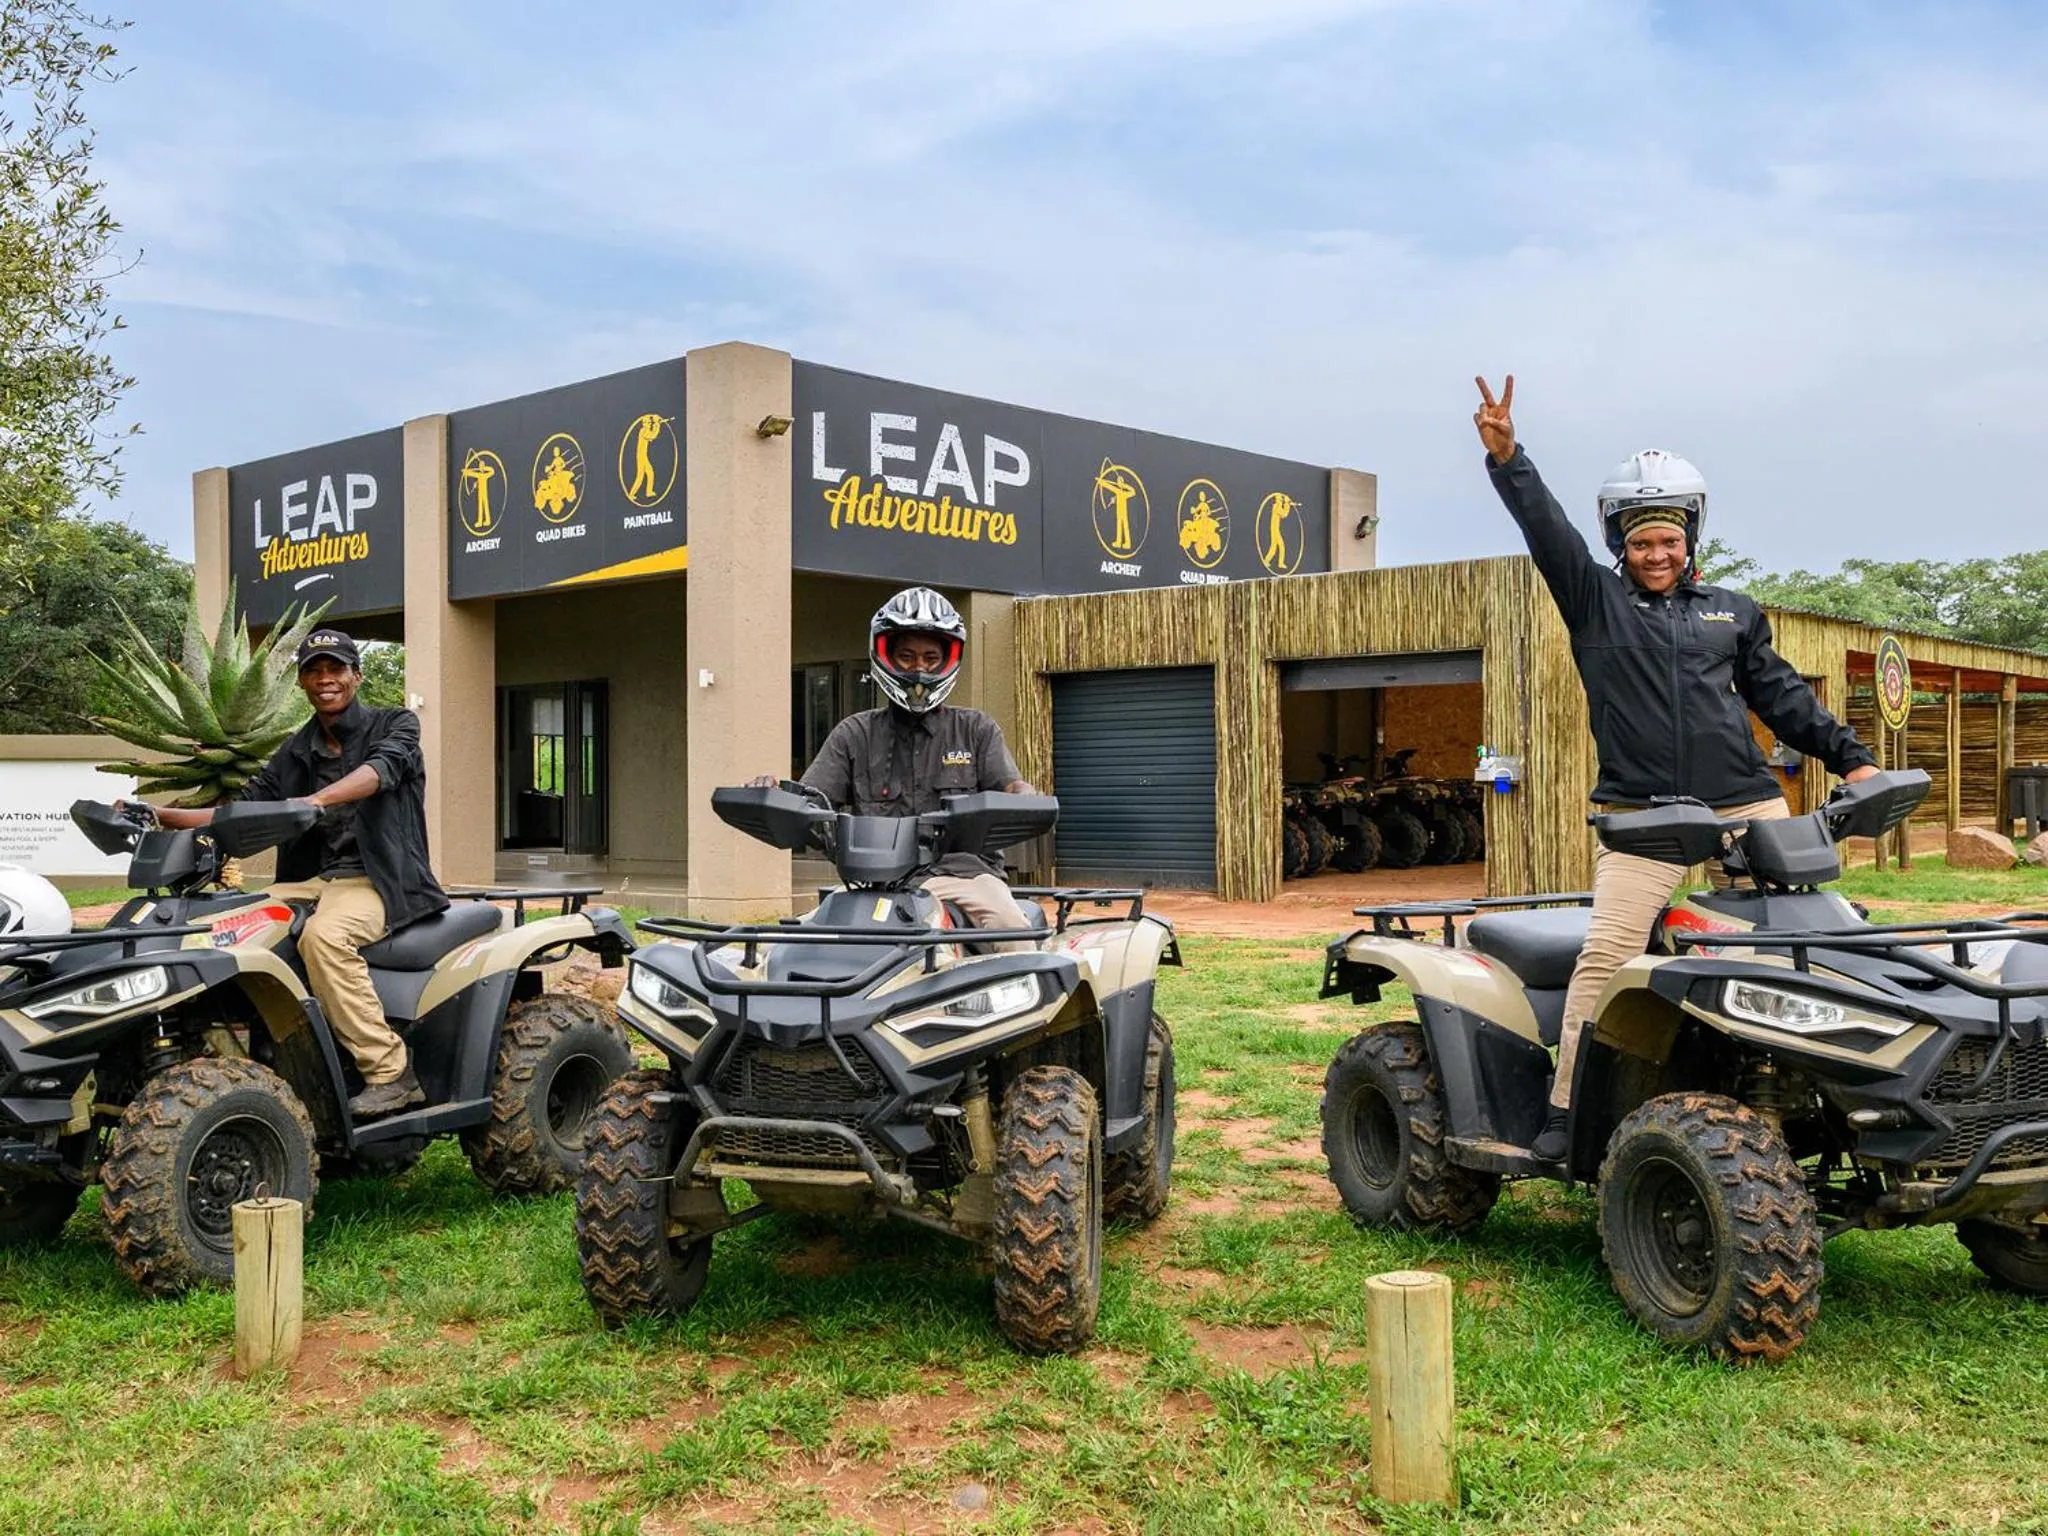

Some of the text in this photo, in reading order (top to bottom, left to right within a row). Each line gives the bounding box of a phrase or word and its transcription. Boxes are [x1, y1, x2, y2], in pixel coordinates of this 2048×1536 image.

[812, 411, 1031, 507] LEAP
[254, 473, 378, 549] LEAP
[823, 474, 1018, 546] Adventures
[623, 511, 673, 530] PAINTBALL
[535, 524, 586, 543] QUAD BIKES
[465, 537, 501, 553] ARCHERY
[260, 531, 369, 580] Adventures
[1100, 560, 1142, 577] ARCHERY
[1180, 570, 1205, 584] QUAD
